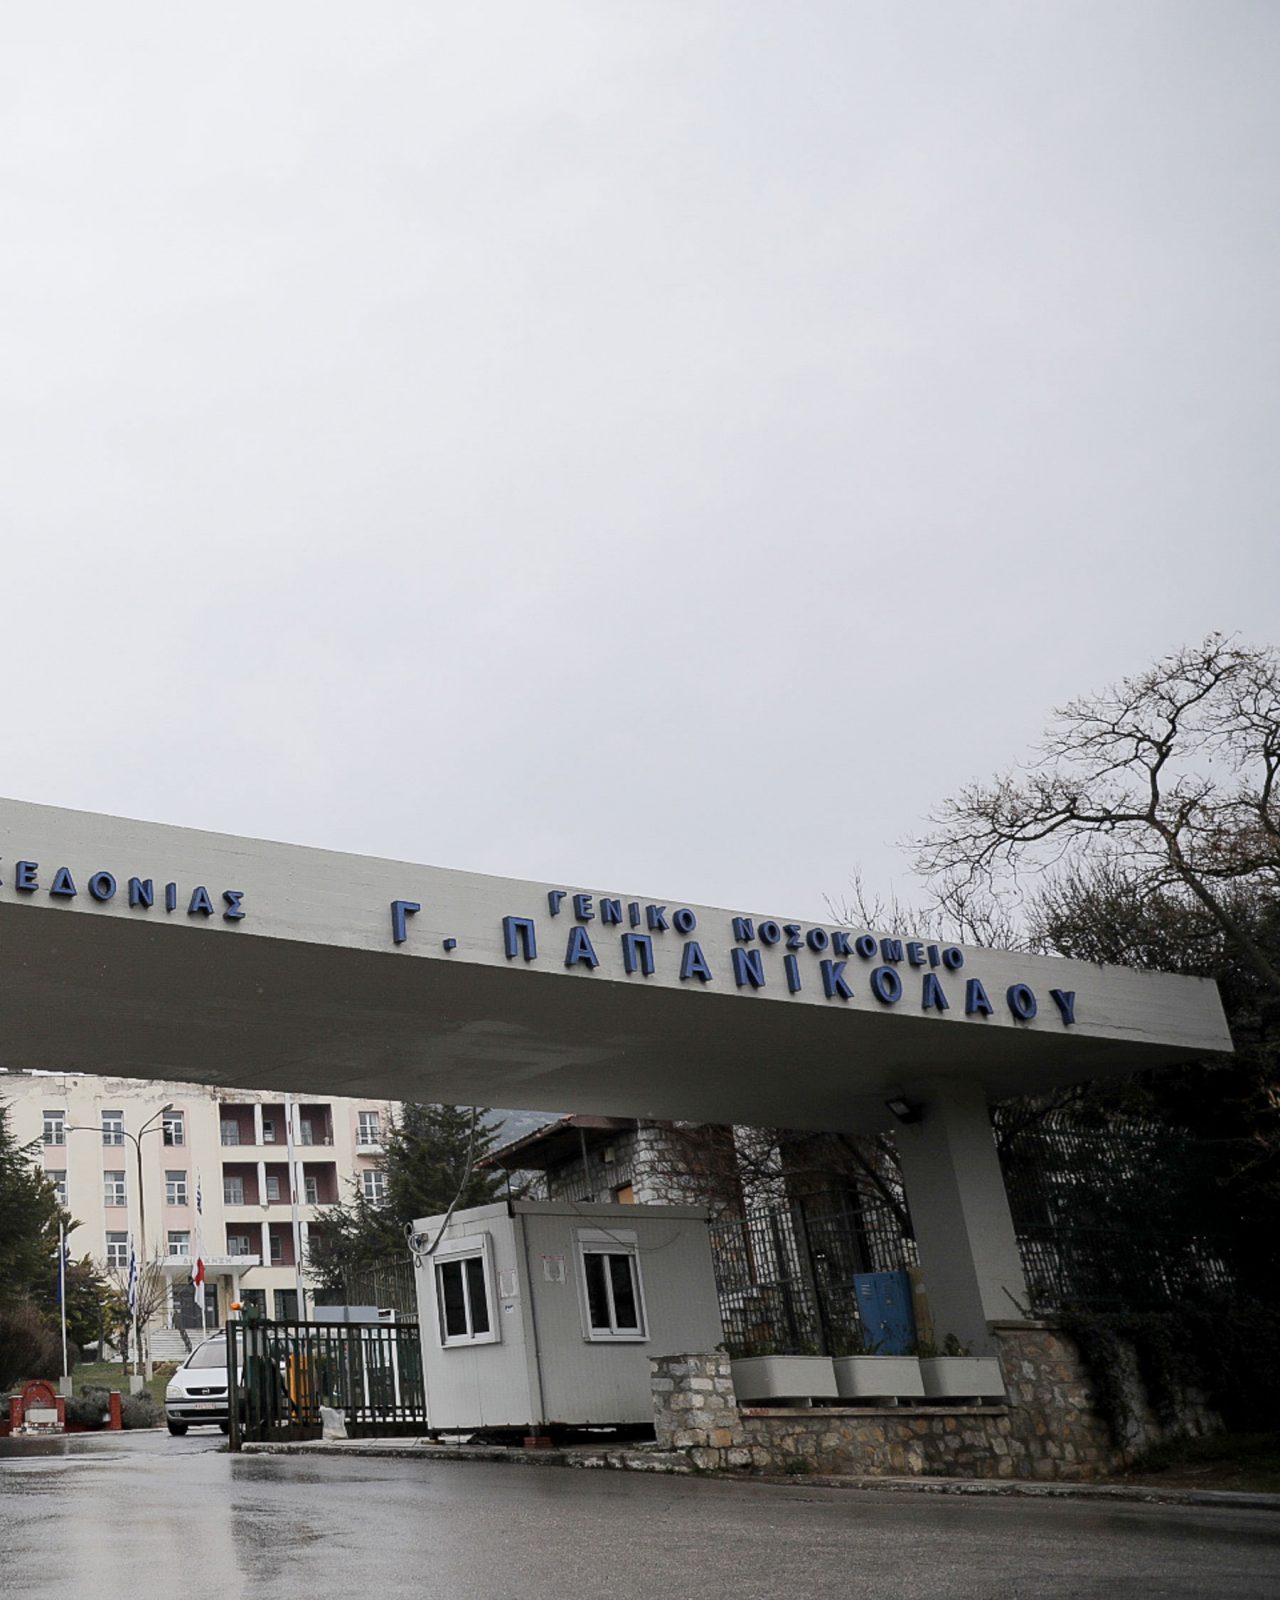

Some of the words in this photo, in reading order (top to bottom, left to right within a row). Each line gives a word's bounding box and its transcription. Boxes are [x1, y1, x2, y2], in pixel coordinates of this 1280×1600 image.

[391, 901, 457, 951] Γ.
[502, 916, 1076, 1026] ΠΑΠΑΝΙΚΟΛΑΟΥ
[548, 890, 697, 934] ΓΕΝΙΚΟ
[732, 917, 964, 970] ΝΟΣΟΚΟΜΕΙΟ
